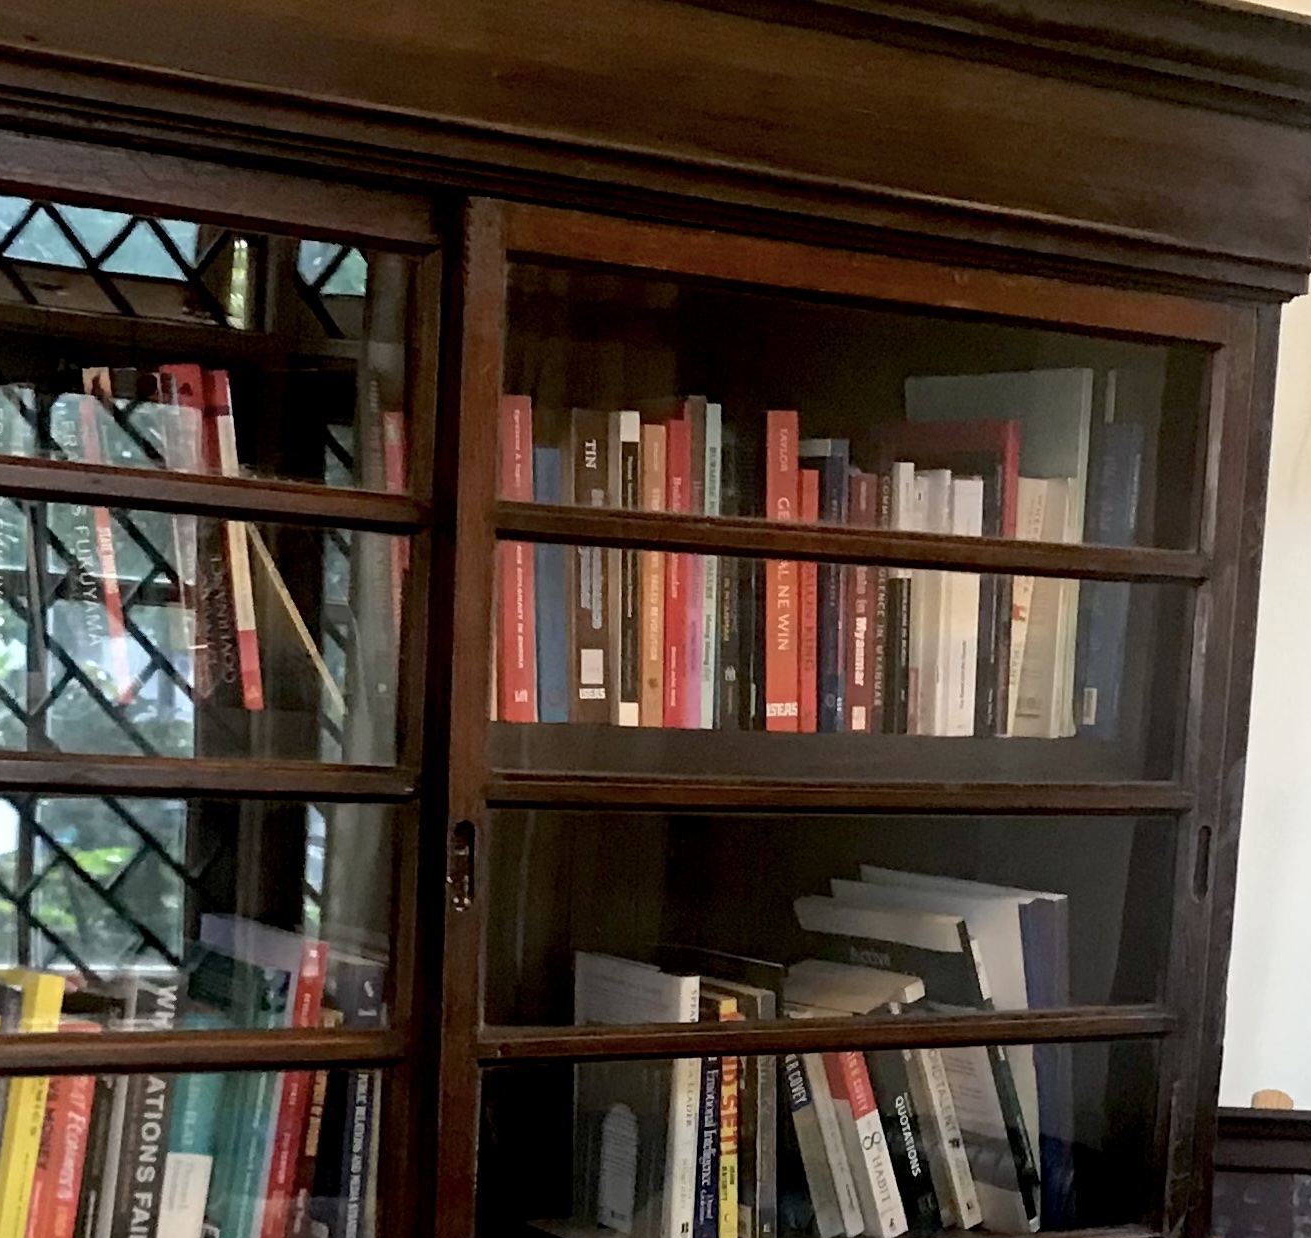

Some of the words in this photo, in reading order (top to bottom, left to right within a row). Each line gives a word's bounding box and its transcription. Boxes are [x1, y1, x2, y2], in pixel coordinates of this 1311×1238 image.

[584, 439, 597, 470] TIN
[778, 428, 789, 472] TAYLOR
[72, 525, 104, 645] FUKUYAMA
[777, 584, 790, 609] NE
[777, 613, 790, 651] WIN
[853, 617, 869, 688] Myanmar
[355, 1073, 368, 1105] PUBLIC
[684, 1081, 695, 1128] LEADER
[703, 1070, 720, 1128] Emotional
[786, 1072, 809, 1105] COVEY
[135, 1075, 167, 1183] ATIONS
[352, 1105, 367, 1154] RELATIONS
[861, 1130, 884, 1152] 8
[892, 1094, 923, 1178] QUOTATIONS
[350, 1154, 363, 1174] AND
[697, 1129, 717, 1187] Intelligence
[869, 1154, 891, 1203] HABIT
[348, 1174, 361, 1203] MEDIA
